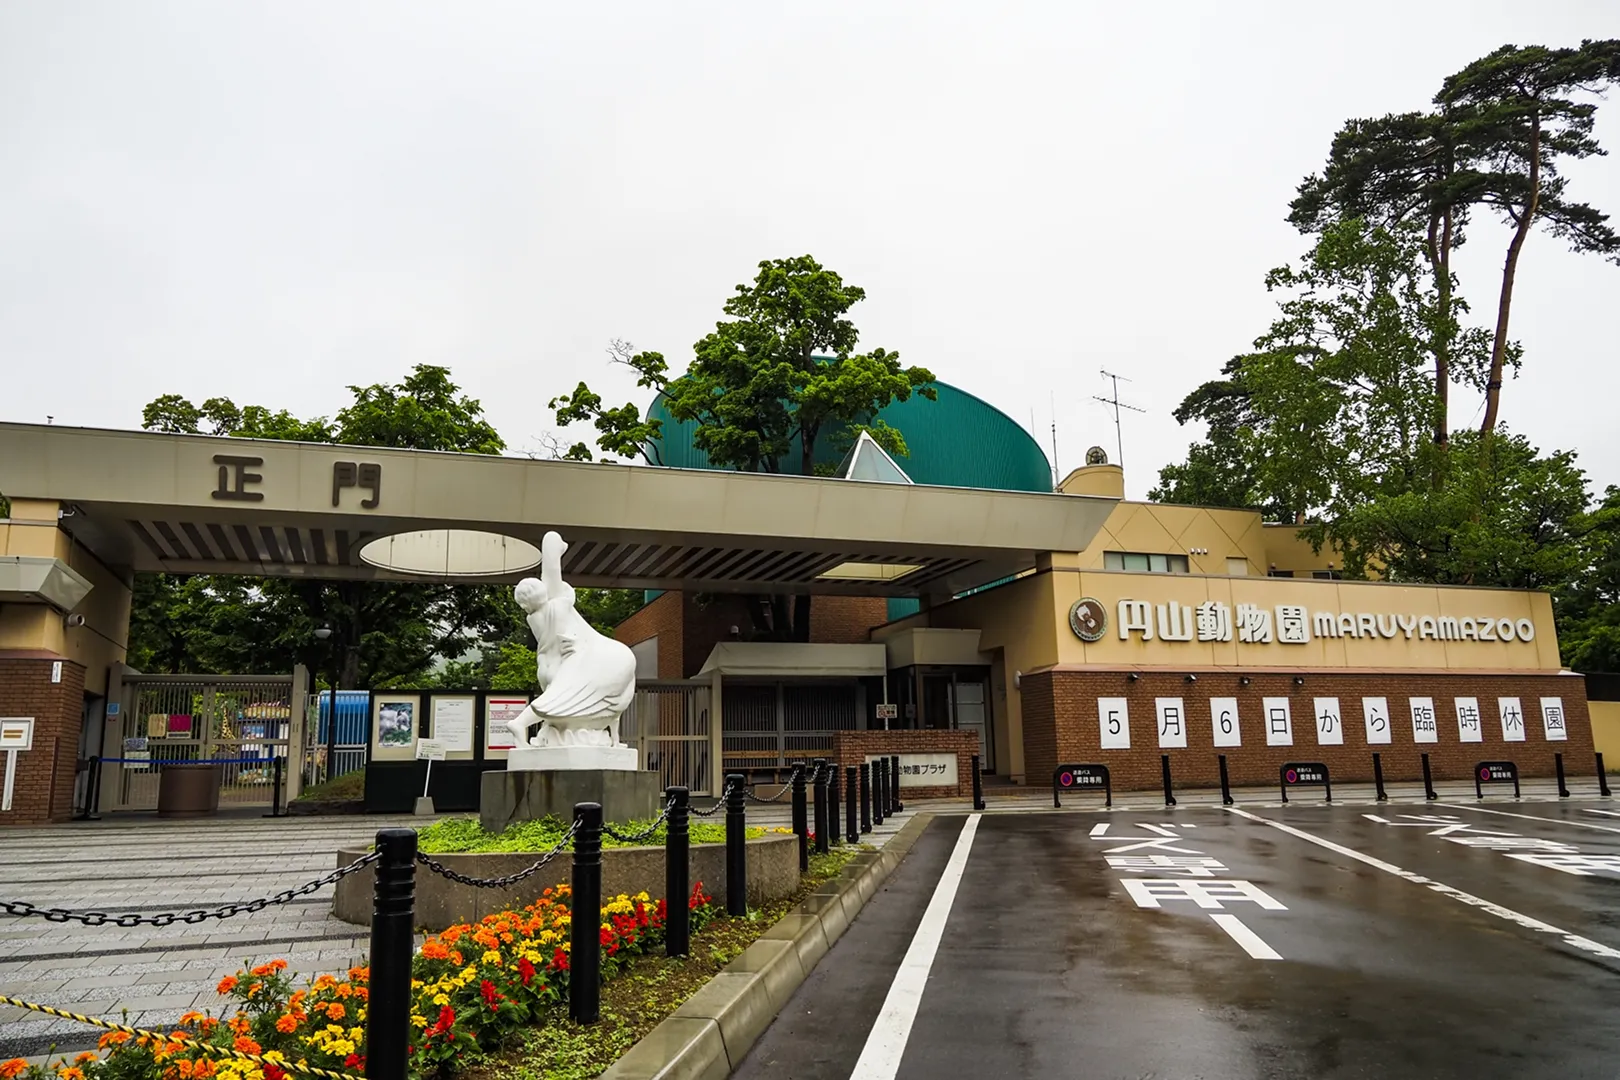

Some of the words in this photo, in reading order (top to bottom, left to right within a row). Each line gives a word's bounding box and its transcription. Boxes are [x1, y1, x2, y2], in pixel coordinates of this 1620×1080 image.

[211, 454, 382, 508] 正門
[1118, 600, 1310, 644] 円山動物園
